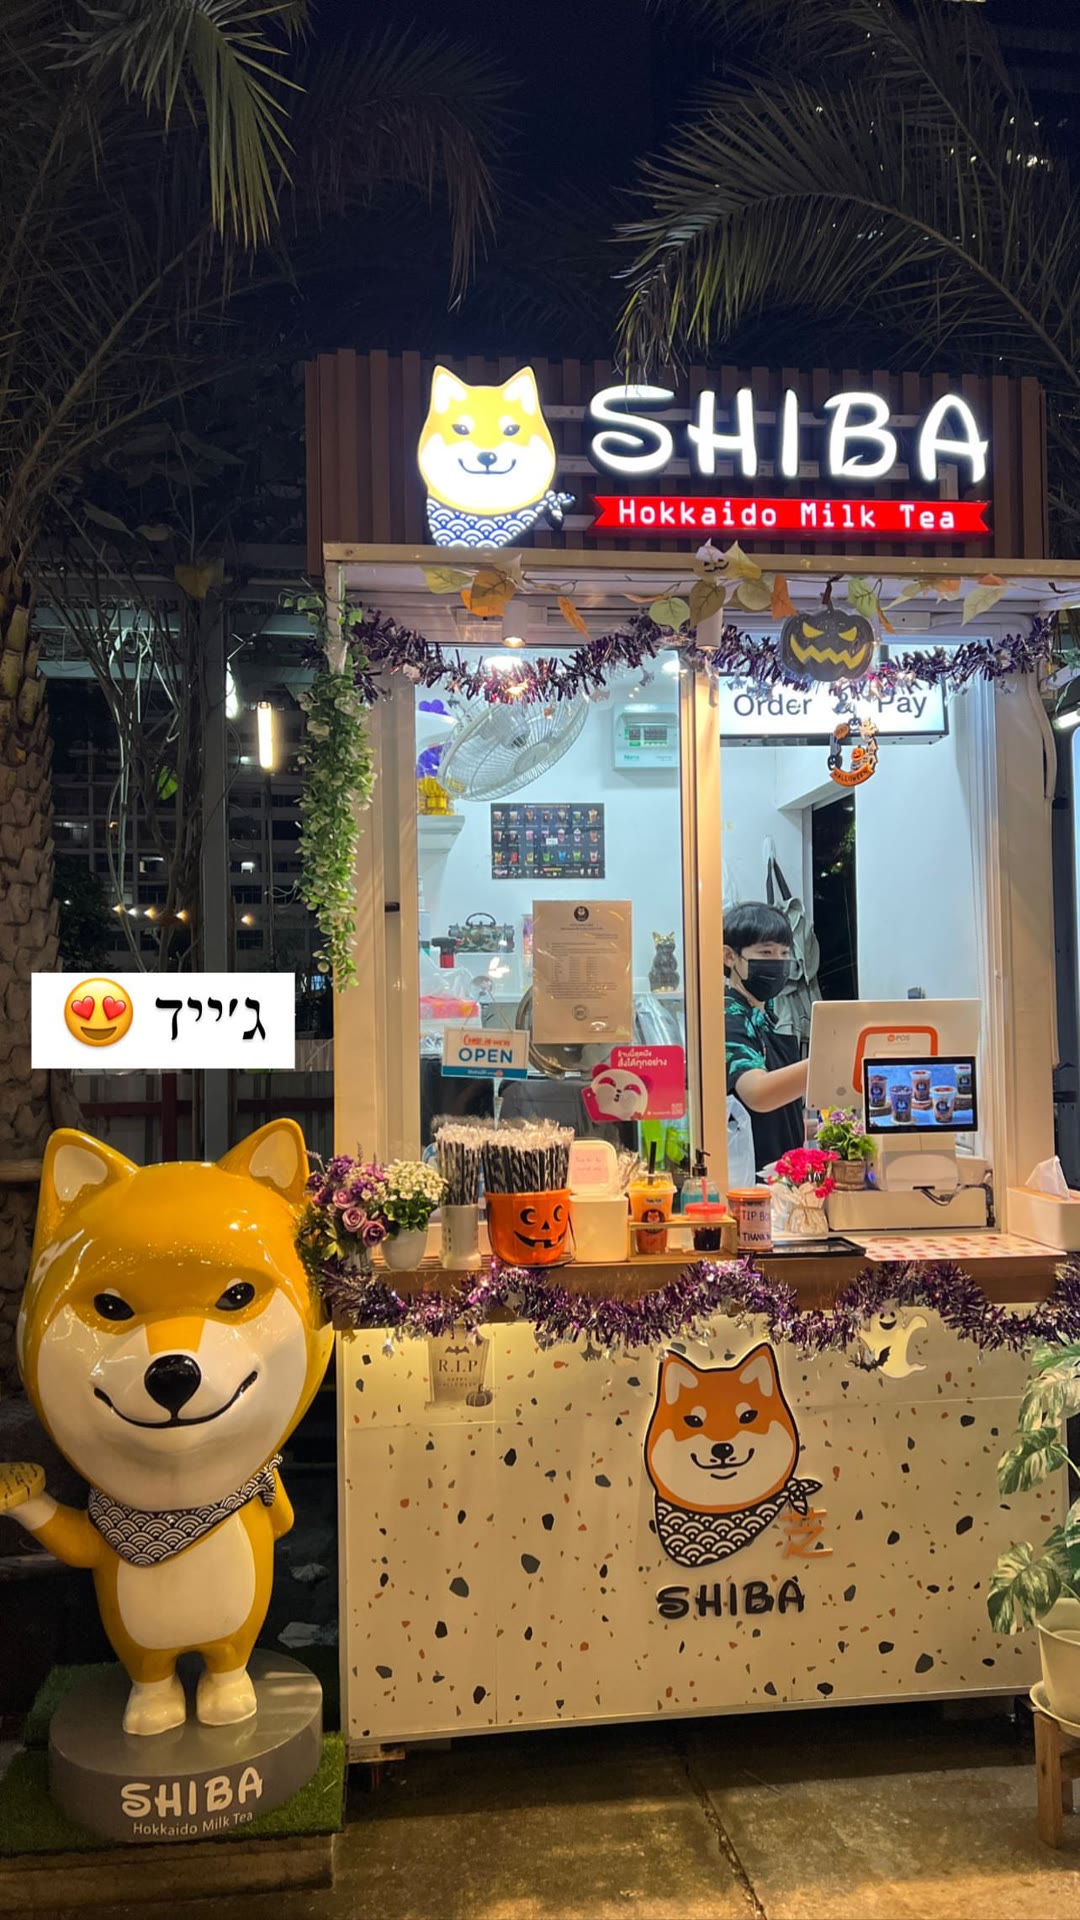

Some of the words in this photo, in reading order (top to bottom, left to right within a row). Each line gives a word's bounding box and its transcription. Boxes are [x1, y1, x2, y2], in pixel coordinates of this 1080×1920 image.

[590, 384, 988, 483] SHIBA
[619, 499, 777, 527] Hokkaido
[801, 502, 876, 528] Milk
[900, 503, 954, 529] Tea
[734, 693, 812, 717] Order
[878, 691, 927, 718] Pay
[458, 1047, 513, 1064] OPEN
[742, 1210, 757, 1220] TIP
[656, 1579, 805, 1619] SHIBA
[121, 1766, 263, 1818] SHIBA
[133, 1822, 198, 1836] Hokkaido
[202, 1816, 230, 1833] Milk
[233, 1811, 253, 1825] Tea
